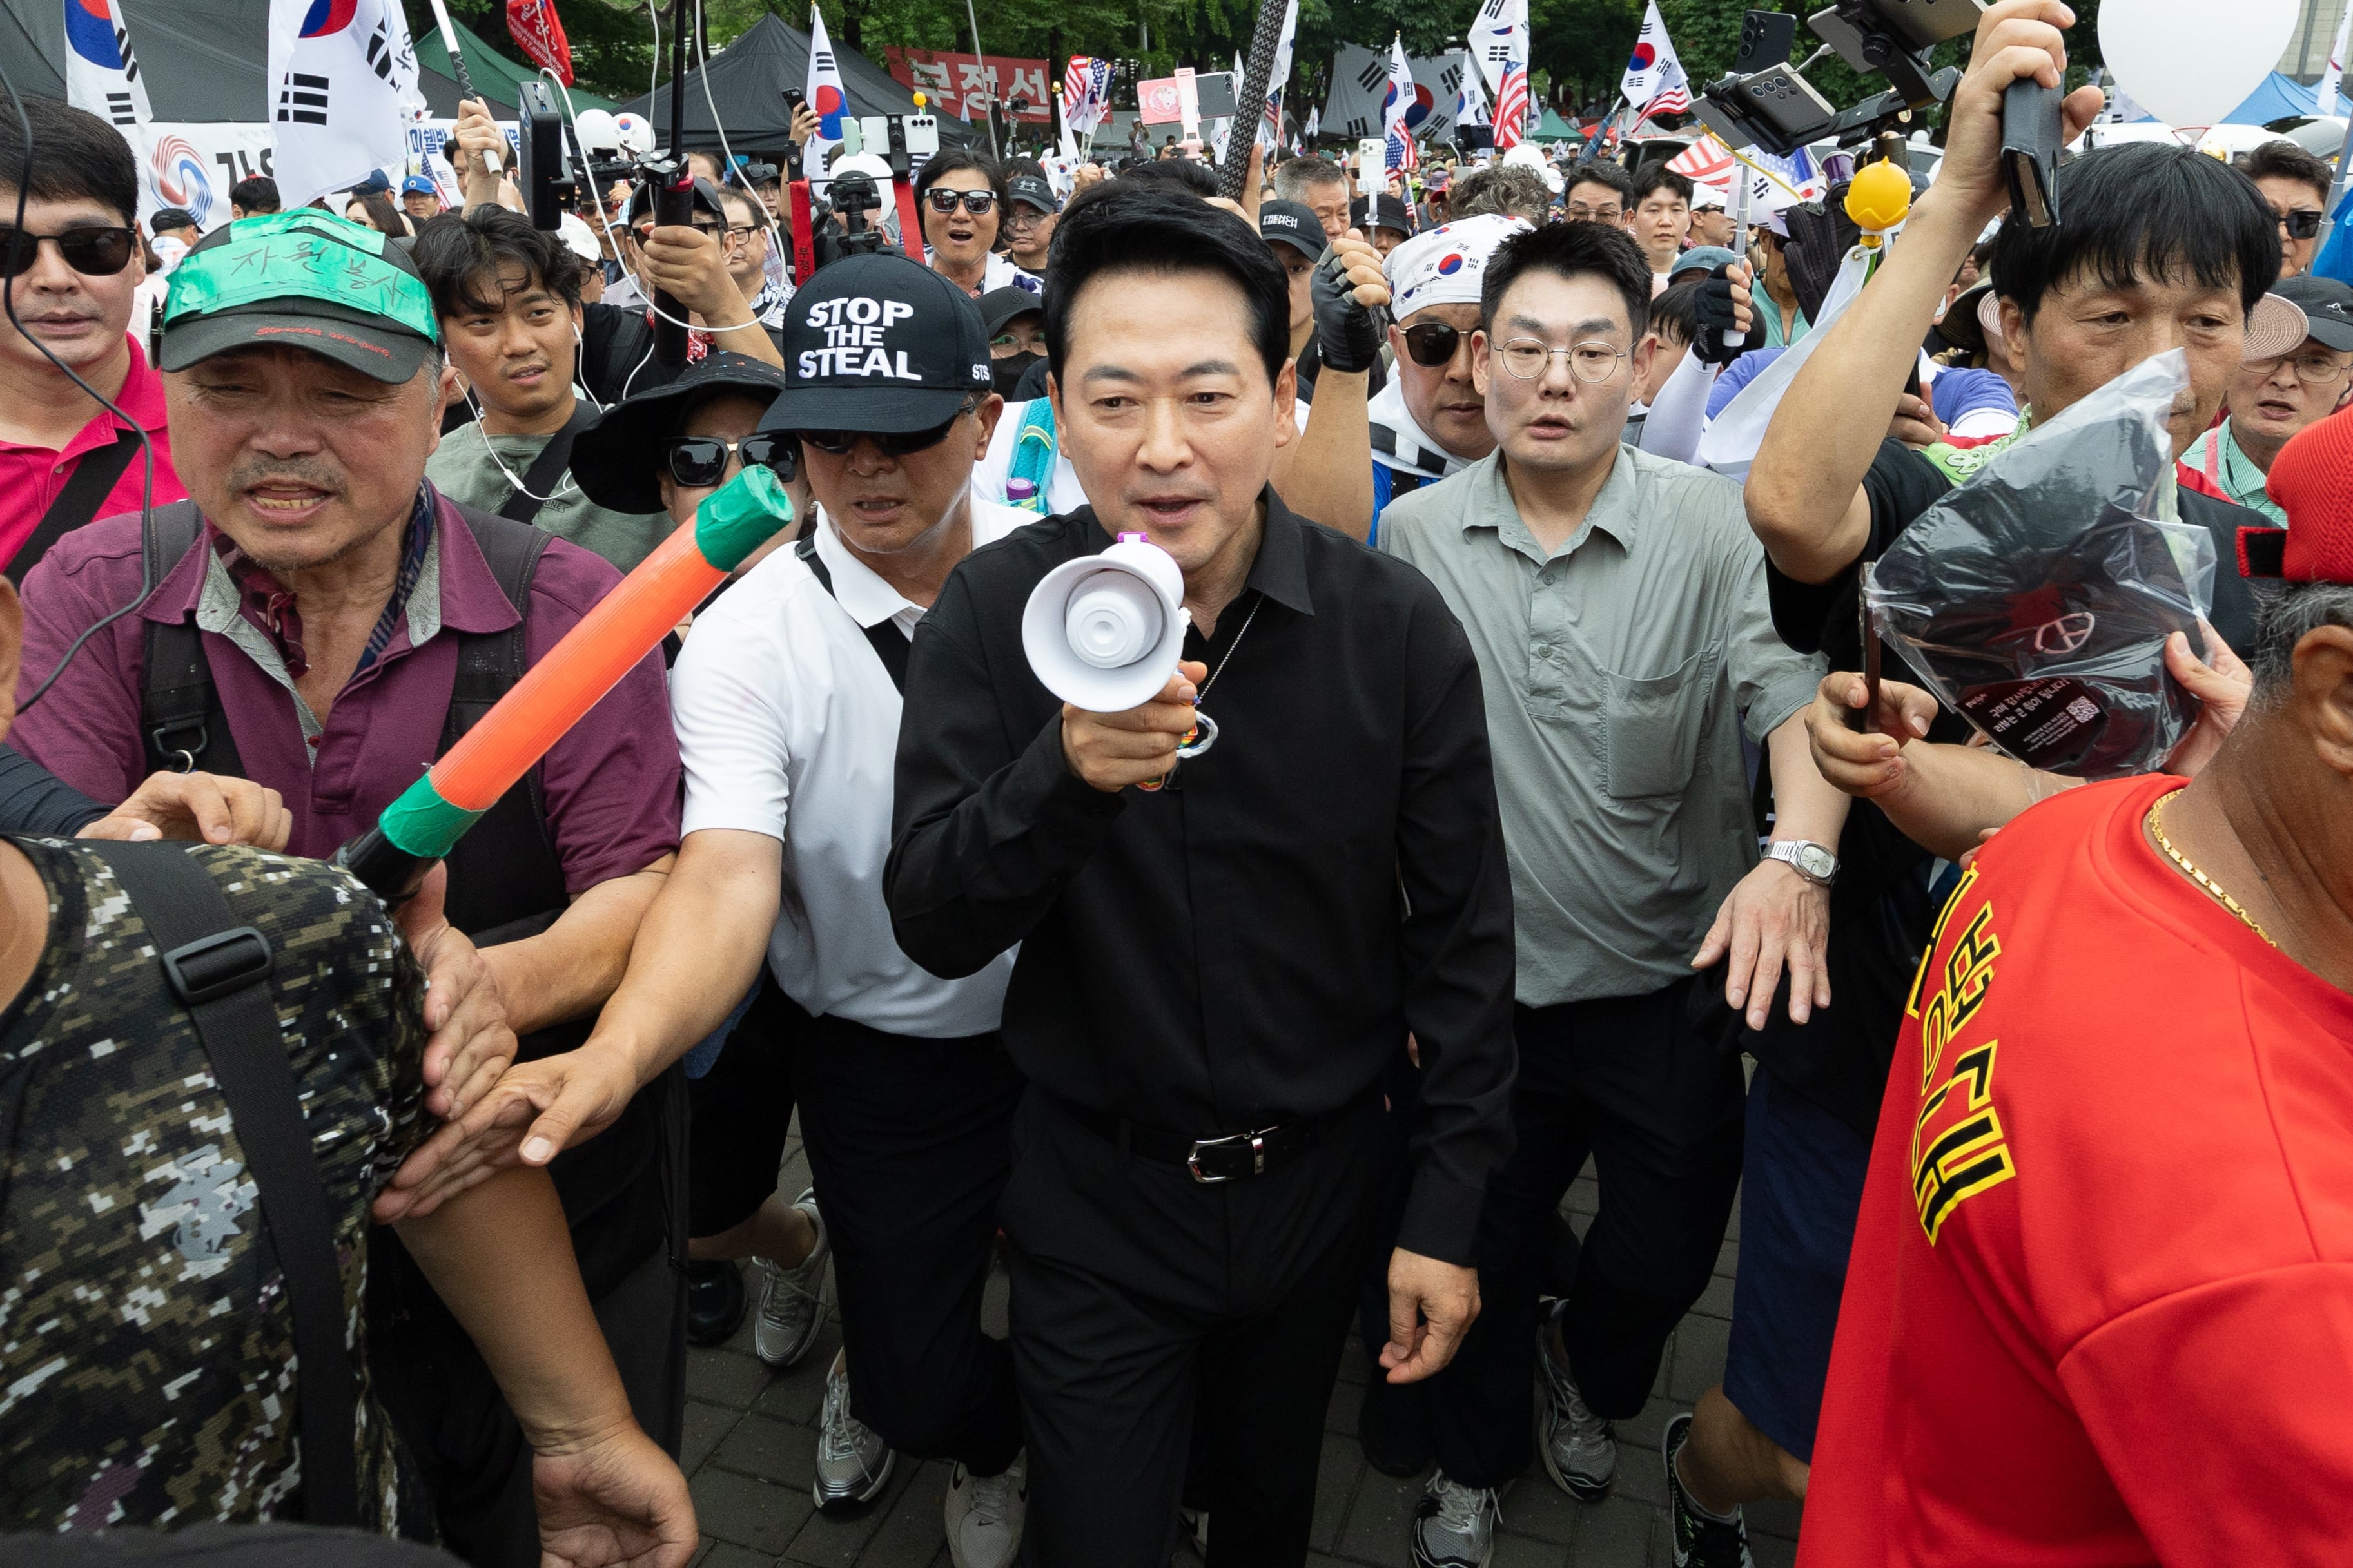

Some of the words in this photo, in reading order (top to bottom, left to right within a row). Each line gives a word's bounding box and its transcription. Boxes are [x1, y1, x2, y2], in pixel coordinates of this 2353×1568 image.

[806, 296, 914, 327] STOP
[823, 324, 886, 347] THE
[798, 347, 923, 382] STEAL
[971, 363, 991, 382] STS
